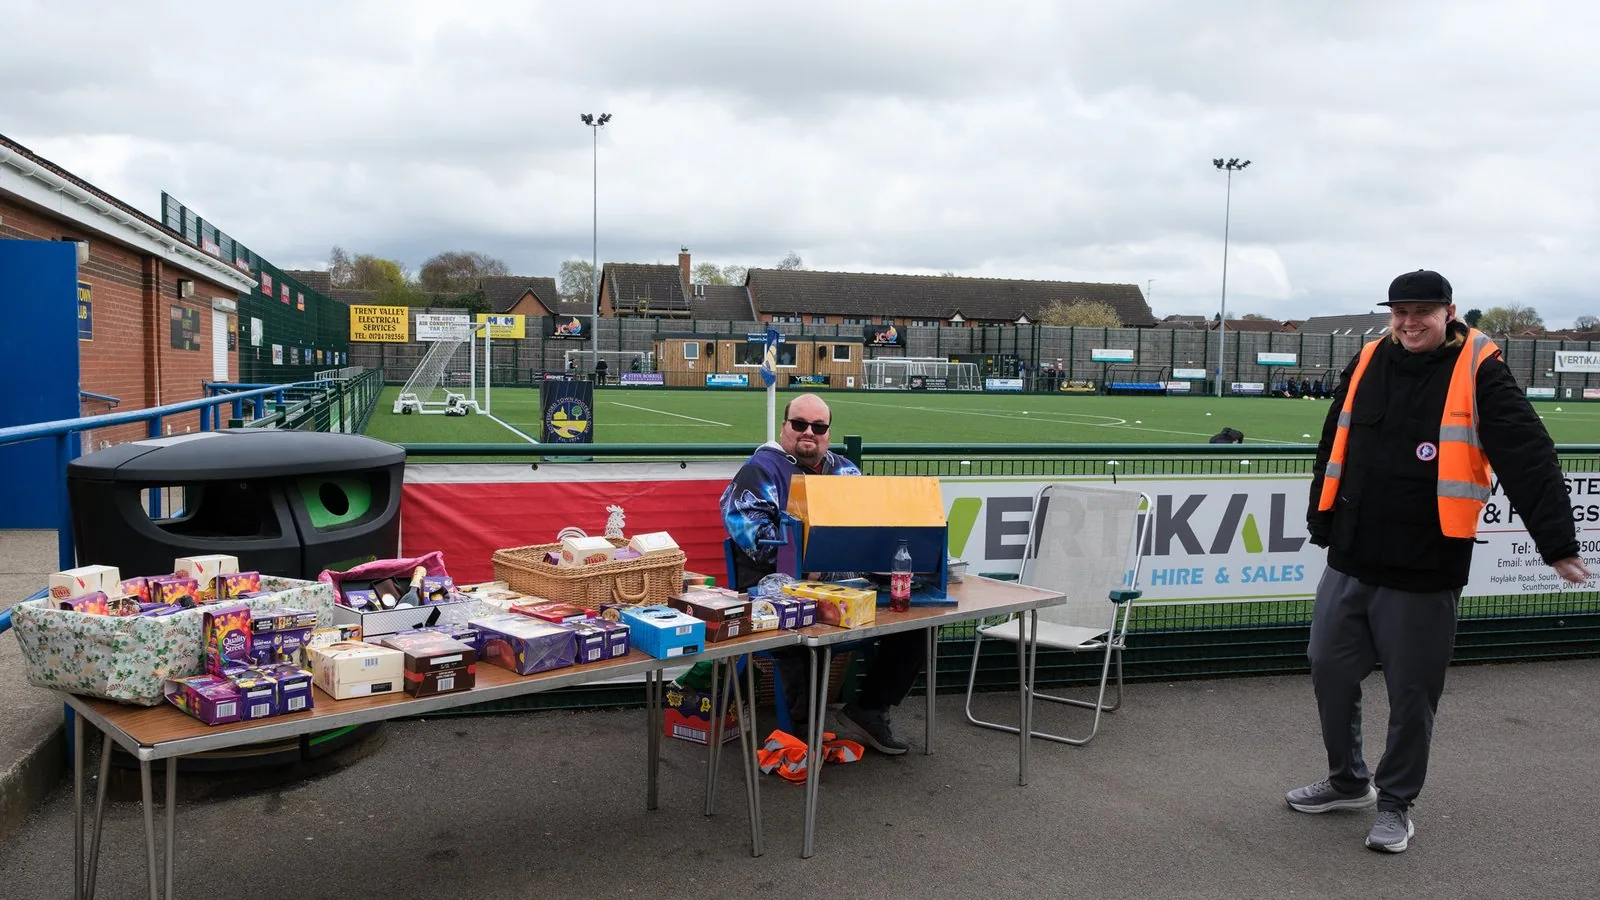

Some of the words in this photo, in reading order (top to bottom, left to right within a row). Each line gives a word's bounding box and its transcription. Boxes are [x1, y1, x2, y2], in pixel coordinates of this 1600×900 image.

[1483, 503, 1501, 523] &
[1512, 542, 1531, 555] Tel:
[1497, 558, 1522, 568] Email:
[1151, 567, 1204, 586] HIRE
[1215, 566, 1229, 584] &
[1241, 564, 1305, 584] SALES
[1490, 575, 1517, 584] Hoylake
[1518, 575, 1537, 583] Road,
[1538, 573, 1558, 581] South
[1522, 583, 1561, 592] Scunthorpe,
[222, 634, 246, 646] Quality
[225, 643, 245, 655] Street
